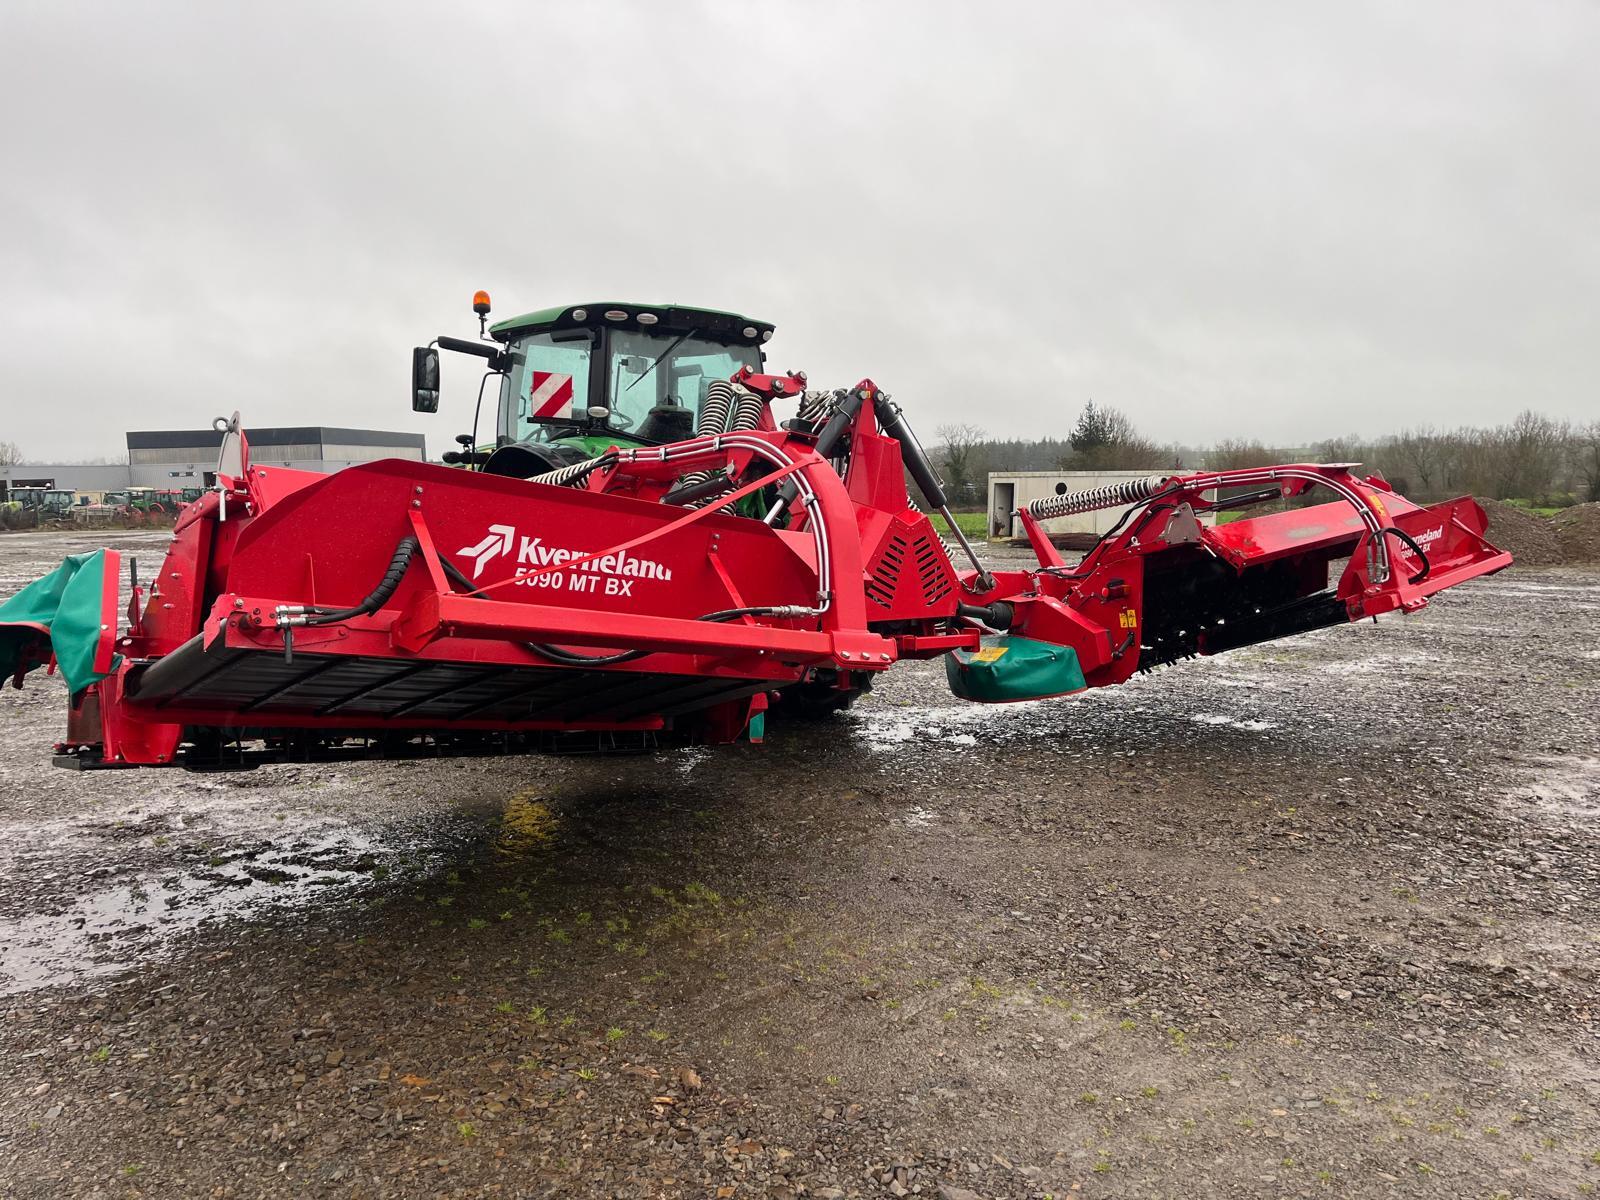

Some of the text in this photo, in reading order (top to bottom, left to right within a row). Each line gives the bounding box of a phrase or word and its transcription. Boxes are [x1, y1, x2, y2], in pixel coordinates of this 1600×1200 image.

[514, 567, 634, 597] 5090 MT BX
